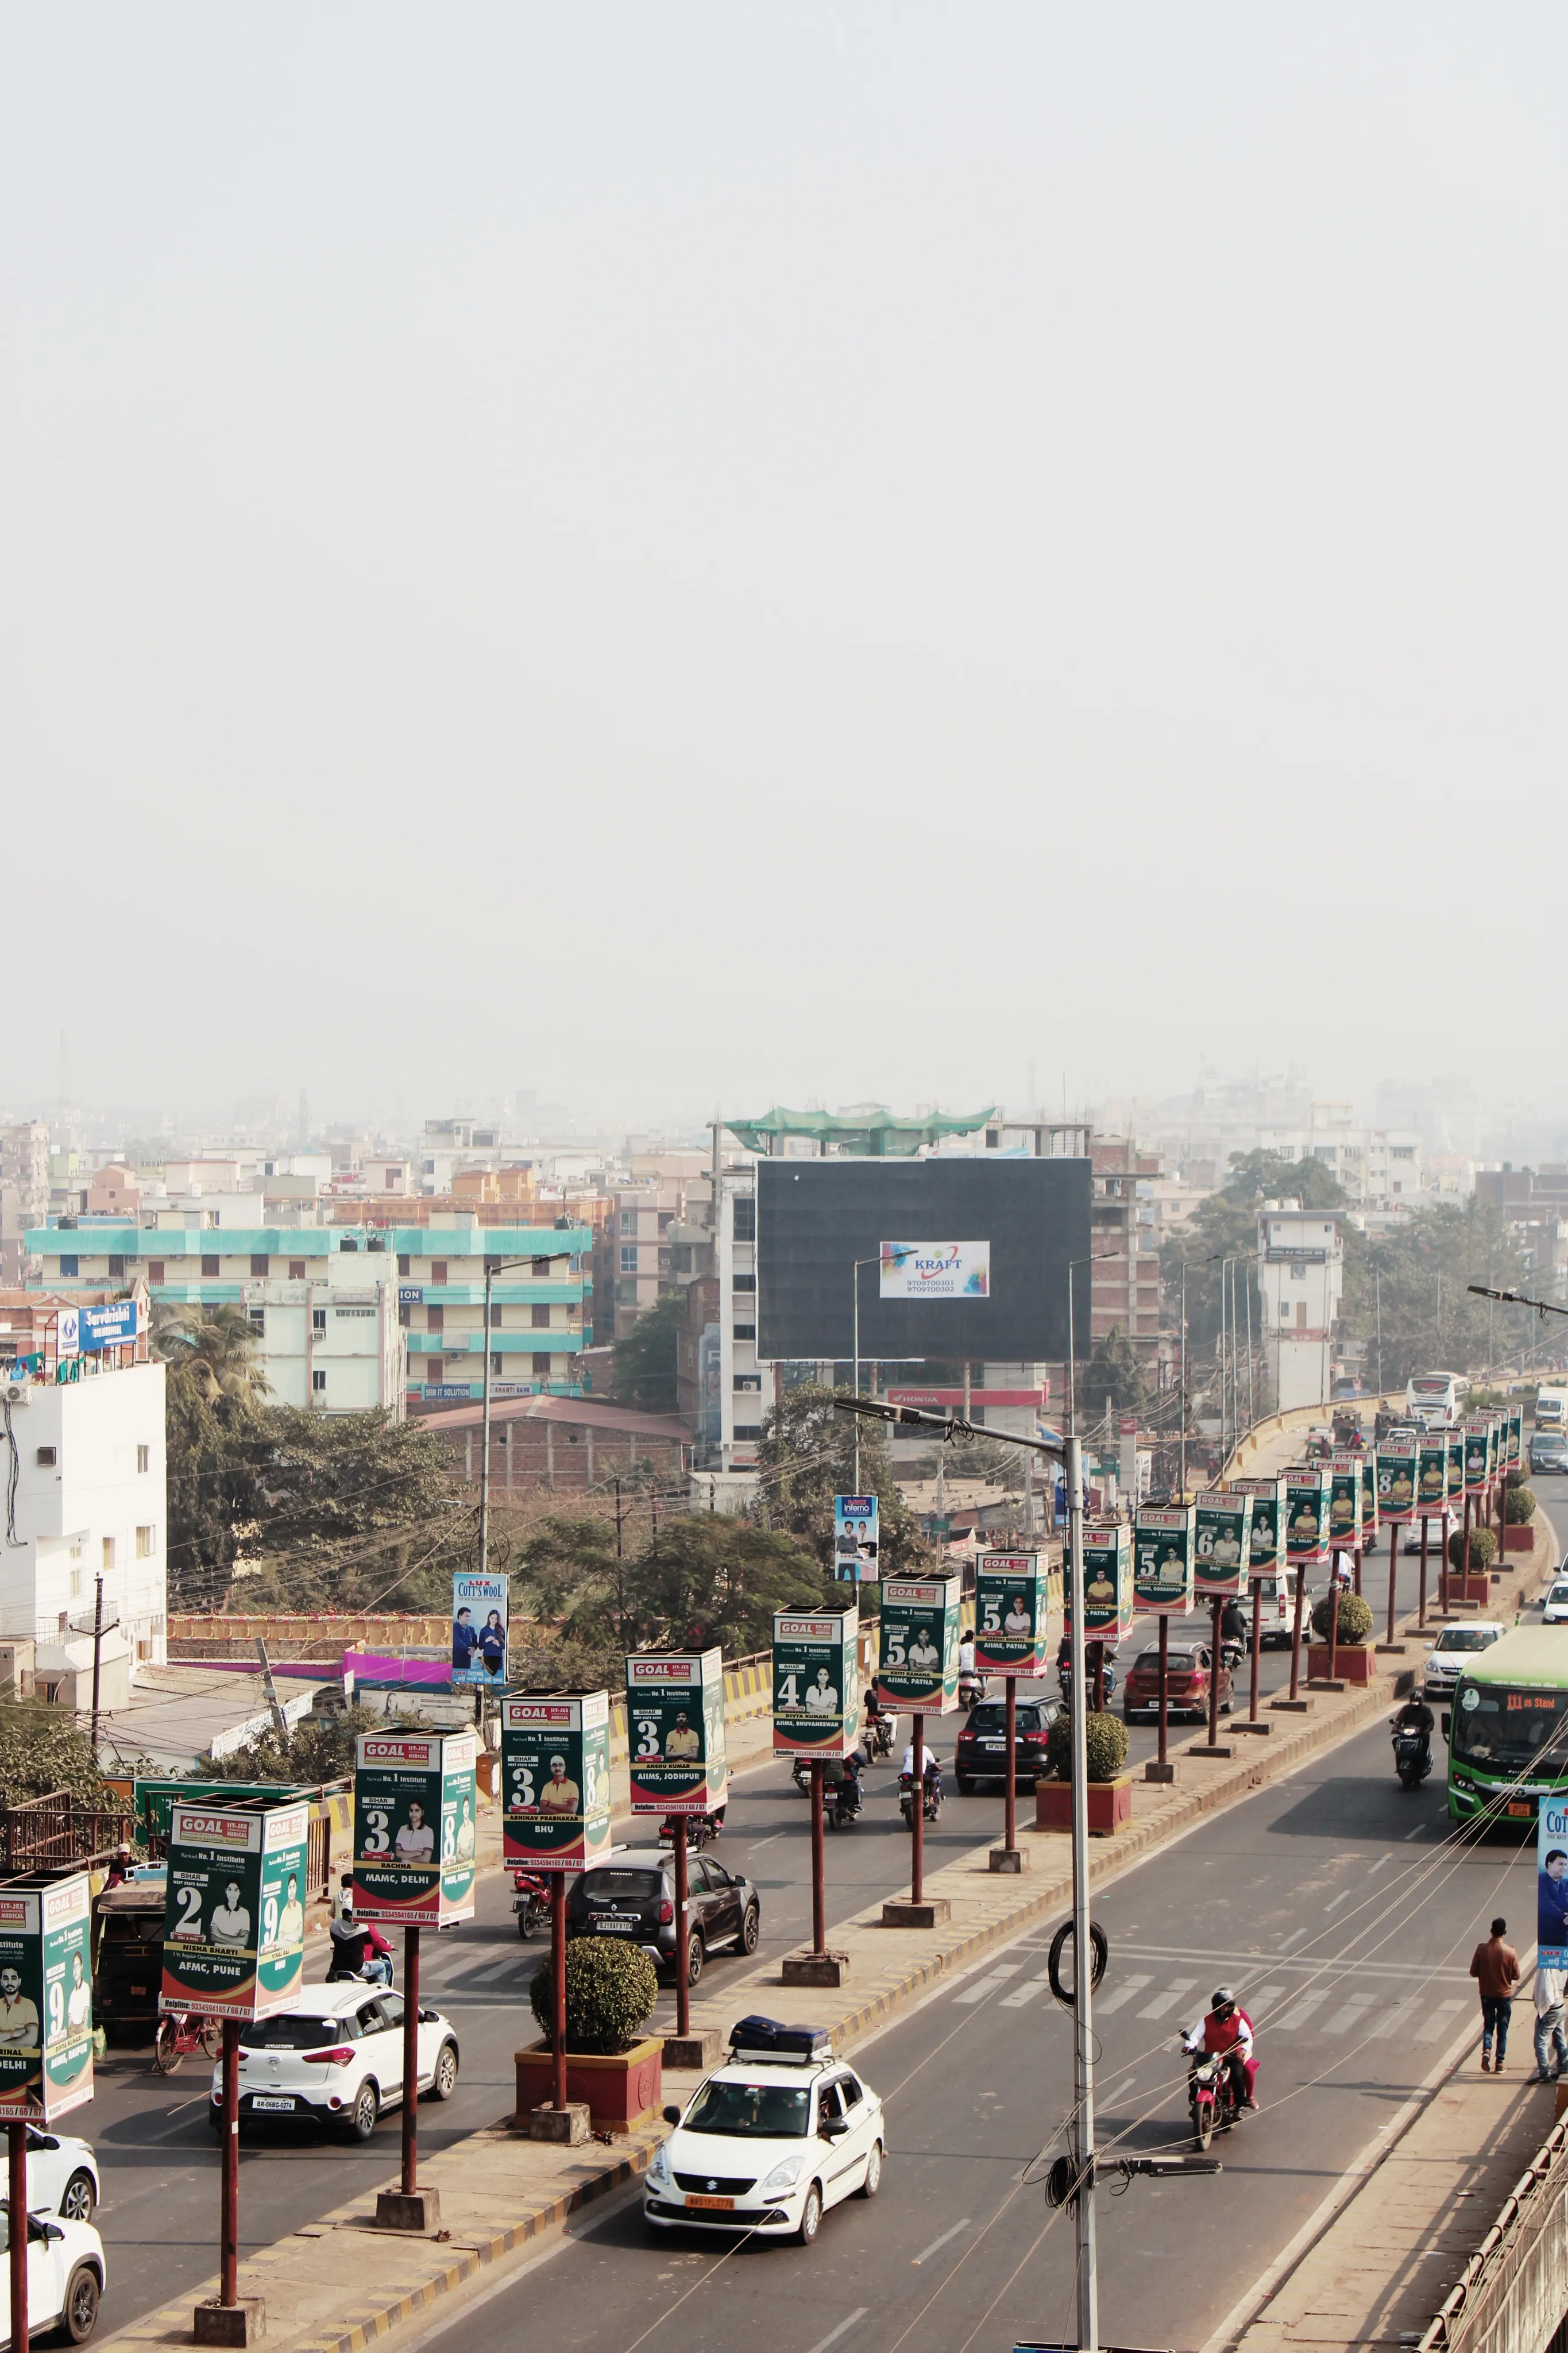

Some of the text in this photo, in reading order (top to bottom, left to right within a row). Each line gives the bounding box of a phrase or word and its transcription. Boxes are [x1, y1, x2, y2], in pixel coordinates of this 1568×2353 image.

[915, 1260, 961, 1269] KRAFT
[93, 1328, 101, 1338] EYE
[426, 1388, 469, 1397] SRM IT SOLUTION
[1379, 1475, 1392, 1494] 8
[1142, 1514, 1165, 1522] GOAL
[1198, 1532, 1213, 1556] 6
[984, 1560, 1011, 1568] GOAL
[1140, 1552, 1156, 1576] 5
[889, 1587, 917, 1596] GOAL
[983, 1603, 1001, 1632] 5
[782, 1623, 812, 1633] GOAL
[887, 1634, 906, 1665] 5
[636, 1665, 669, 1674] GOAL
[778, 1675, 800, 1707] 4
[1507, 1694, 1522, 1709] 111
[1534, 1698, 1555, 1708] Stand
[512, 1707, 547, 1718] GOAL
[538, 1734, 542, 1742] 1
[638, 1721, 659, 1756] 3
[366, 1744, 404, 1756] GOAL
[393, 1773, 398, 1782] 1
[638, 1773, 662, 1781] AIIMS,
[512, 1768, 535, 1806] 3
[587, 1766, 596, 1806] 8
[182, 1818, 223, 1833] GOAL
[270, 1820, 290, 1837] GOAL
[365, 1810, 390, 1853] 3
[445, 1815, 455, 1859] 8
[198, 1852, 208, 1860] No.
[210, 1850, 215, 1861] 1
[217, 1854, 245, 1864] Institute
[366, 1873, 429, 1884] MAMC, DELHI
[49, 1895, 70, 1915] GOAL
[175, 1887, 202, 1935] 2
[263, 1896, 278, 1946] 9
[183, 1944, 238, 1955] NISHA BHARTI
[179, 1961, 241, 1976] AFMC, PUNE
[49, 1981, 64, 2036] 9
[165, 2000, 191, 2009] Helpline:
[191, 2003, 226, 2013] 9334594165
[68, 2034, 82, 2047] KUMARI
[19, 2108, 41, 2116] 66 67
